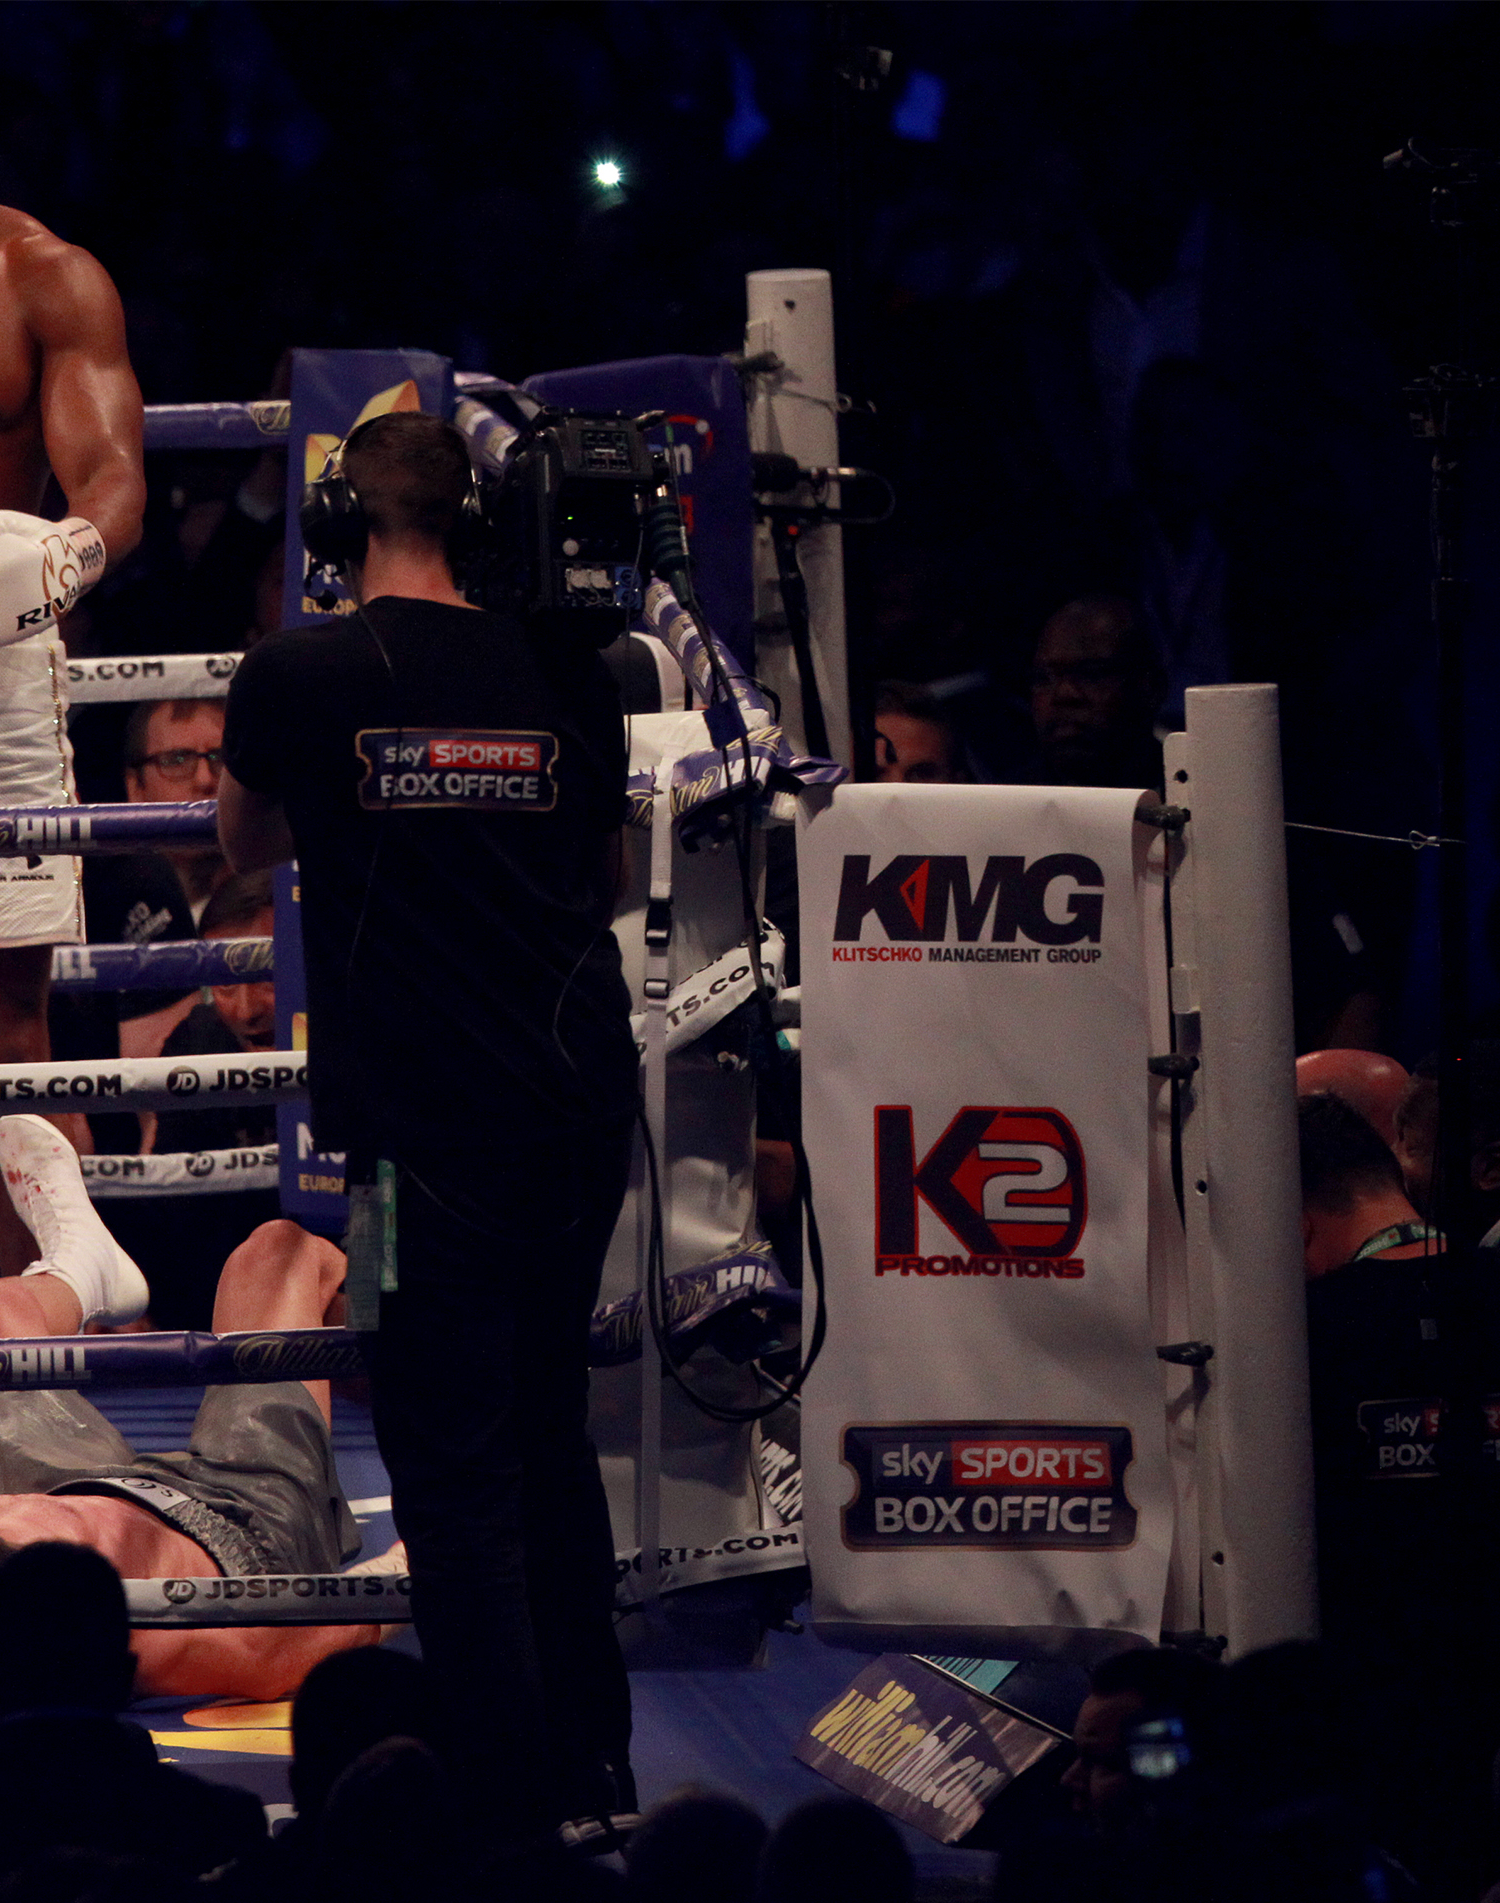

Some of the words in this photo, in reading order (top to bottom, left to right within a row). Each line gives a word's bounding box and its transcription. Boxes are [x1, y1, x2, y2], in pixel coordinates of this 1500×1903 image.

[385, 743, 425, 767] sky
[434, 745, 535, 766] SPORTS
[381, 773, 441, 797] BOX
[445, 773, 538, 799] OFFICE
[16, 817, 98, 849] HILL
[832, 853, 1105, 945] KMG
[832, 947, 922, 962] KLITSCHKO
[929, 948, 1040, 963] MANAGEMENT
[1047, 949, 1101, 963] GROUP
[874, 1254, 1085, 1279] PROMOTIONS
[11, 1347, 91, 1383] HILL
[1383, 1412, 1421, 1437] sky
[882, 1444, 943, 1484] sky
[960, 1447, 1105, 1480] SPORTS
[1379, 1443, 1436, 1469] BOX
[874, 1496, 965, 1533] BOX
[972, 1496, 1112, 1533] OFFICE
